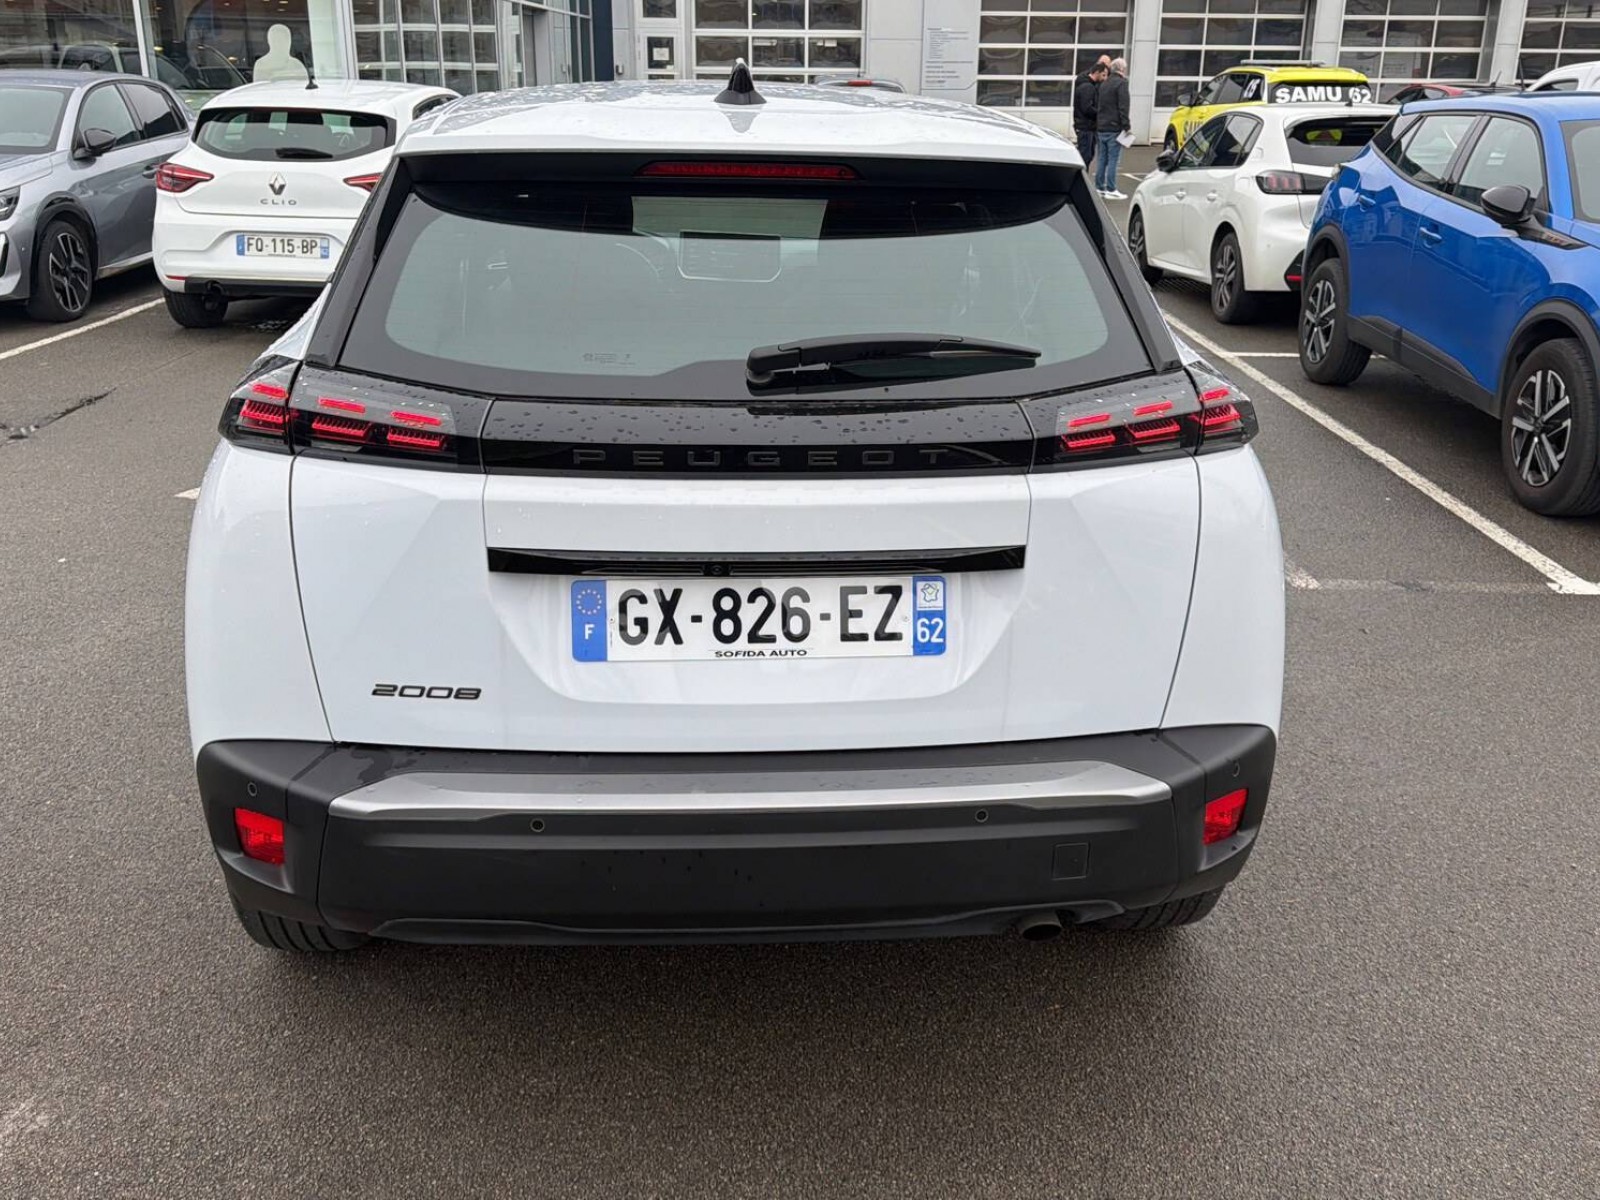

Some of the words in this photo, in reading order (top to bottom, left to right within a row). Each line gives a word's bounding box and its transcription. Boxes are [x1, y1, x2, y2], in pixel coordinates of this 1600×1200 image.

[1275, 86, 1342, 104] SAMU
[1348, 87, 1372, 104] 62
[572, 449, 949, 466] PEUGEOT
[618, 585, 903, 646] GX-826-EZ
[584, 623, 595, 640] F
[916, 617, 944, 643] 62
[714, 650, 766, 658] SOFIDA
[769, 649, 808, 657] AUTO
[371, 683, 482, 700] 2008
